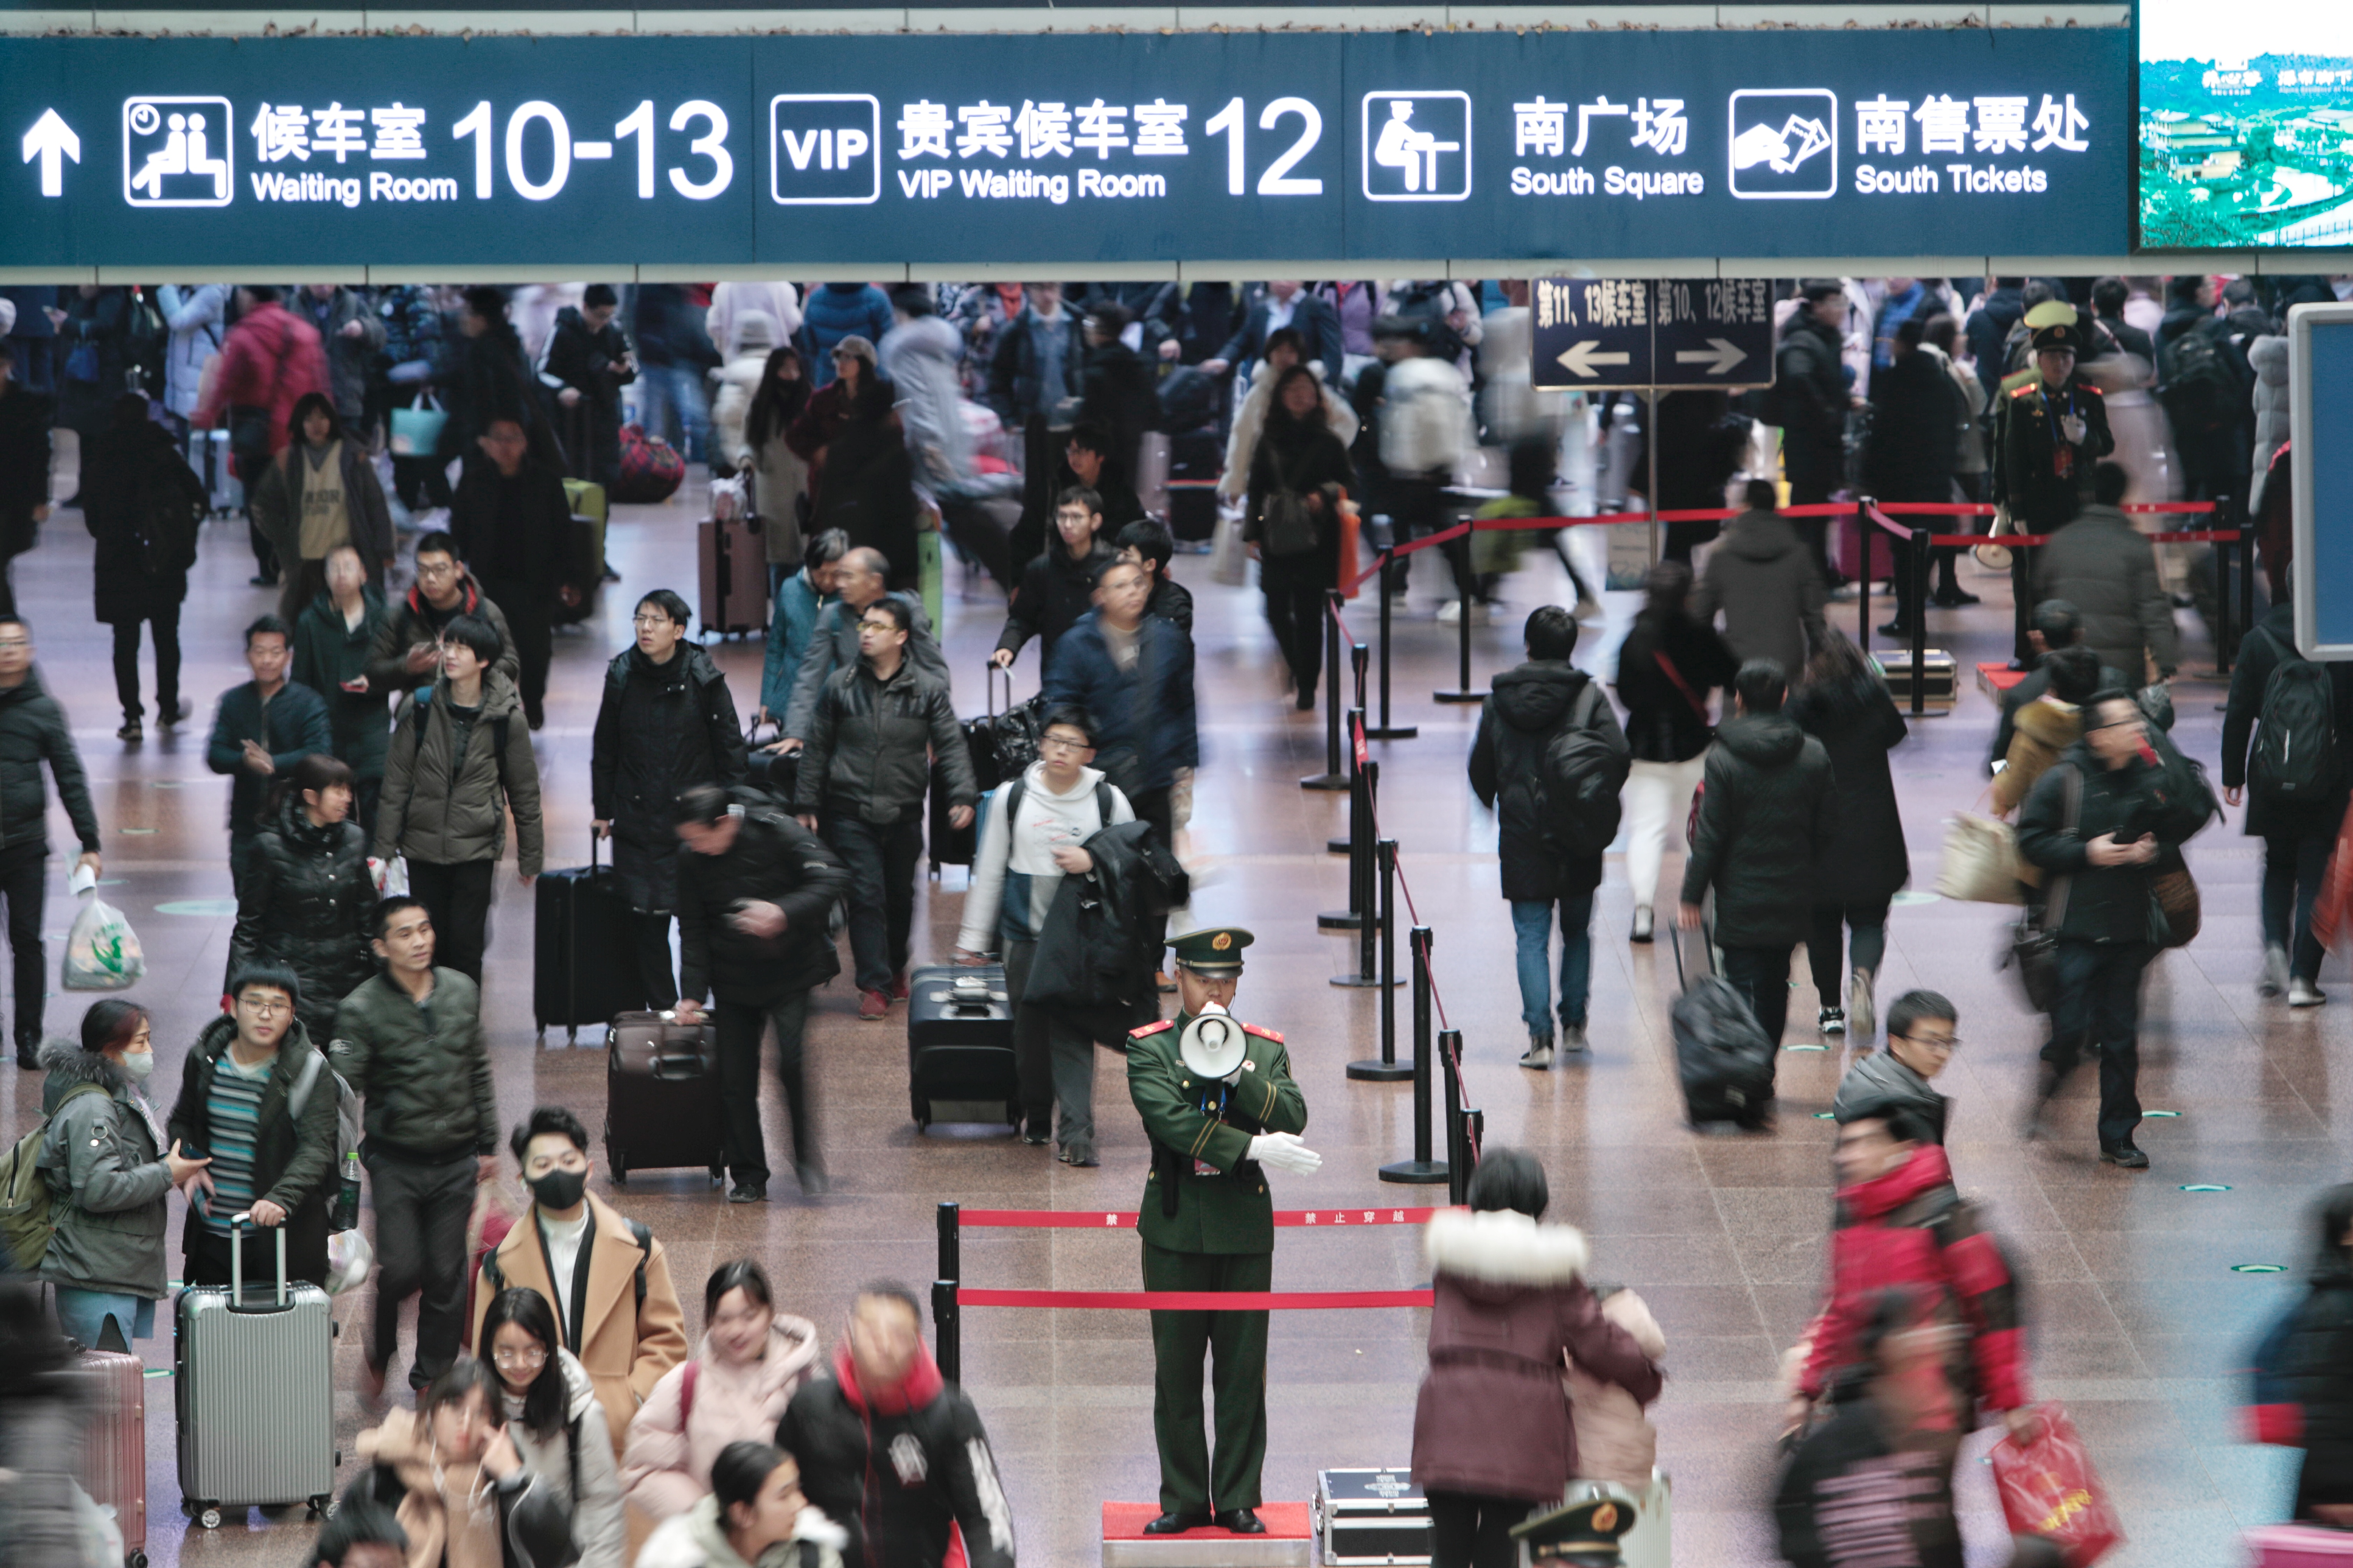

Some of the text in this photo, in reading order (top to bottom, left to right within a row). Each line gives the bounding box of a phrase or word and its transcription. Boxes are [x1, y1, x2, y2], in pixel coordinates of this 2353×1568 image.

[250, 101, 426, 163] 候车室
[897, 98, 1189, 160] 贵宾候车室
[1206, 97, 1323, 195] 12
[1513, 95, 1688, 157] 南广场
[1855, 93, 2089, 155] 南售票处
[452, 99, 733, 201] 10-13
[782, 129, 869, 170] VIP
[251, 172, 457, 207] Waiting Room
[897, 169, 1166, 204] VIP Waiting Room
[1511, 166, 1704, 201] South Square
[1855, 164, 2047, 194] South Tickets
[1537, 279, 1647, 329] 第11、13候车室
[1657, 279, 1767, 326] 第10、12候车室
